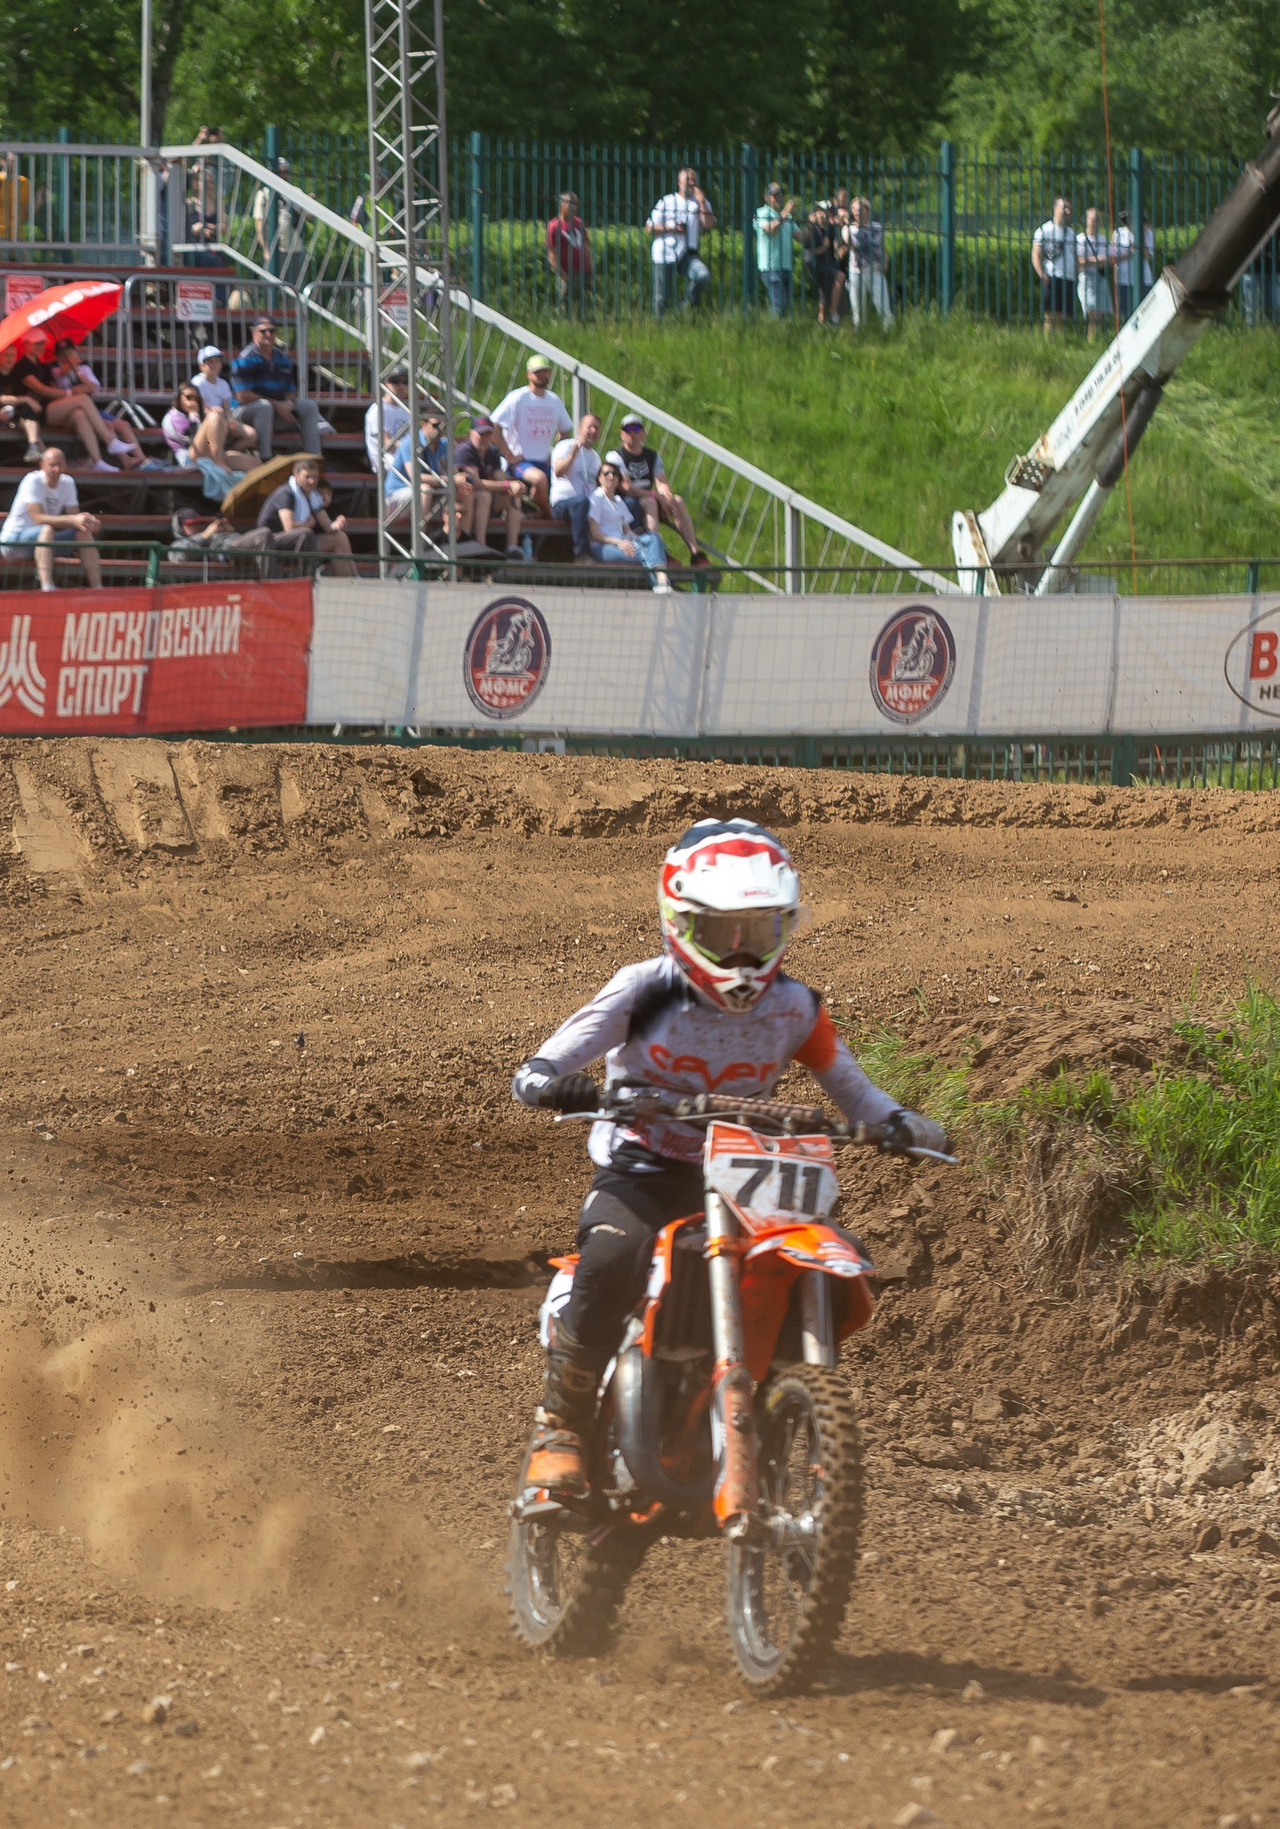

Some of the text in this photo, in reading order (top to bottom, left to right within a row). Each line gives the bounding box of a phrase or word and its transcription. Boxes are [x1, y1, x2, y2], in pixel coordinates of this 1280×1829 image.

[61, 594, 242, 662] МОСКОВСКИЙ
[56, 664, 150, 717] СПОРТ
[479, 678, 531, 697] МФМС
[885, 682, 932, 701] МФМС
[730, 1157, 823, 1216] 711
